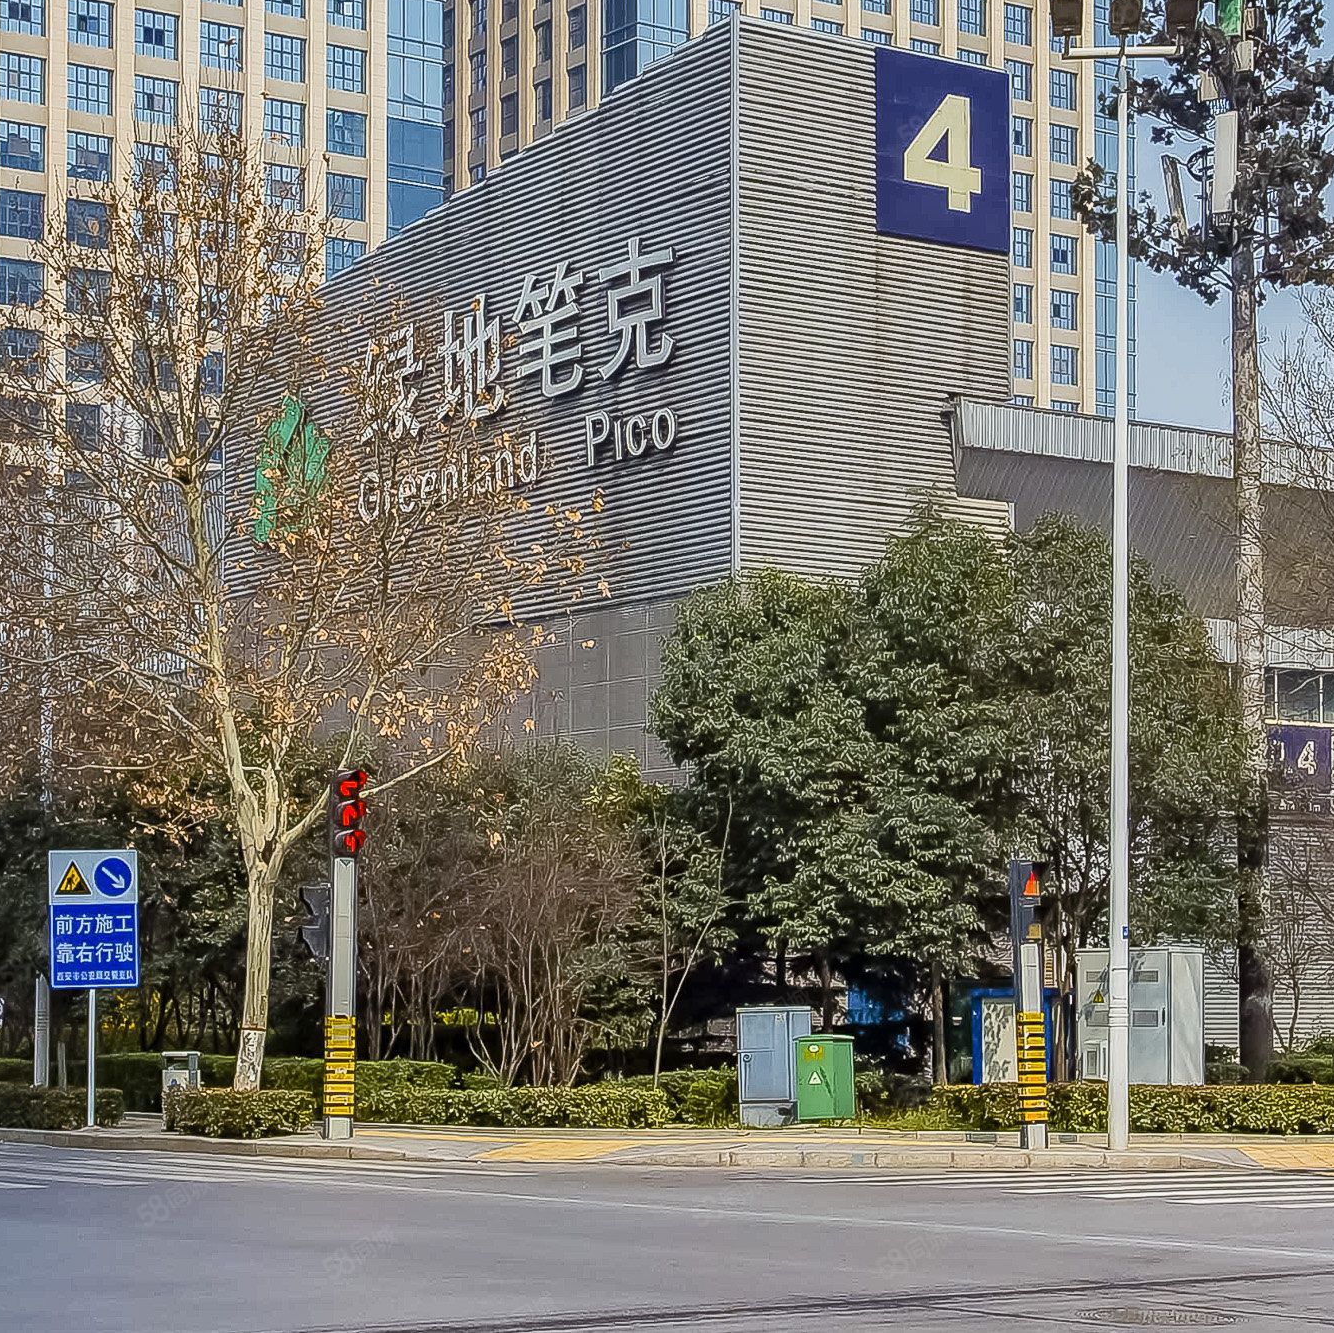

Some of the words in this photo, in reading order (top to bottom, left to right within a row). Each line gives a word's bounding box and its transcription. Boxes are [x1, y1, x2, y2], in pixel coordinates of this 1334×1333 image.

[903, 93, 982, 214] 4
[584, 407, 677, 467] Pico
[1297, 740, 1317, 775] 4
[55, 913, 133, 935] 前方施工
[55, 941, 134, 964] 靠右行驶
